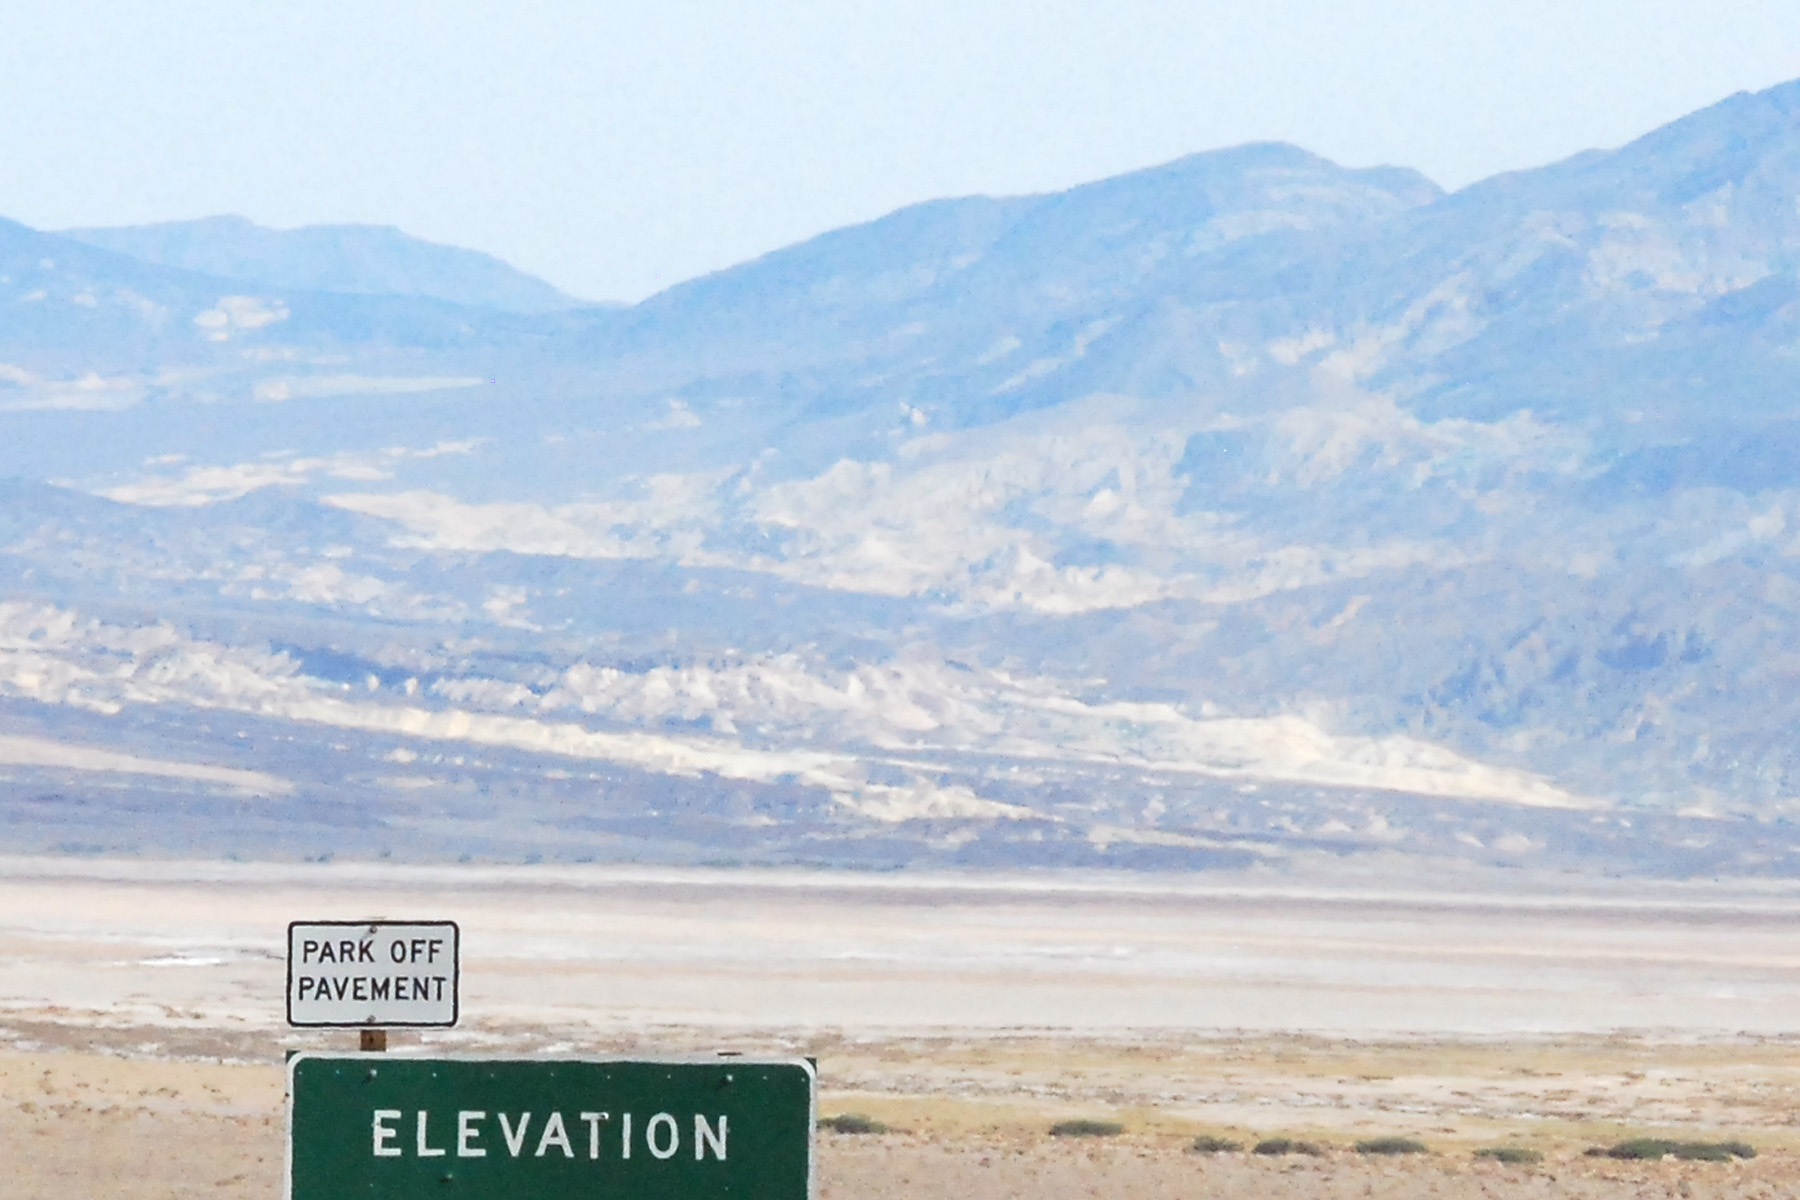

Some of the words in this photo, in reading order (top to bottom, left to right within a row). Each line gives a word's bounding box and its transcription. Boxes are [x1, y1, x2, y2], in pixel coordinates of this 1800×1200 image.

[302, 939, 375, 964] PARK
[390, 939, 444, 964] OFF
[298, 976, 447, 1002] PAVEMENT
[372, 1109, 729, 1161] ELEVATION
